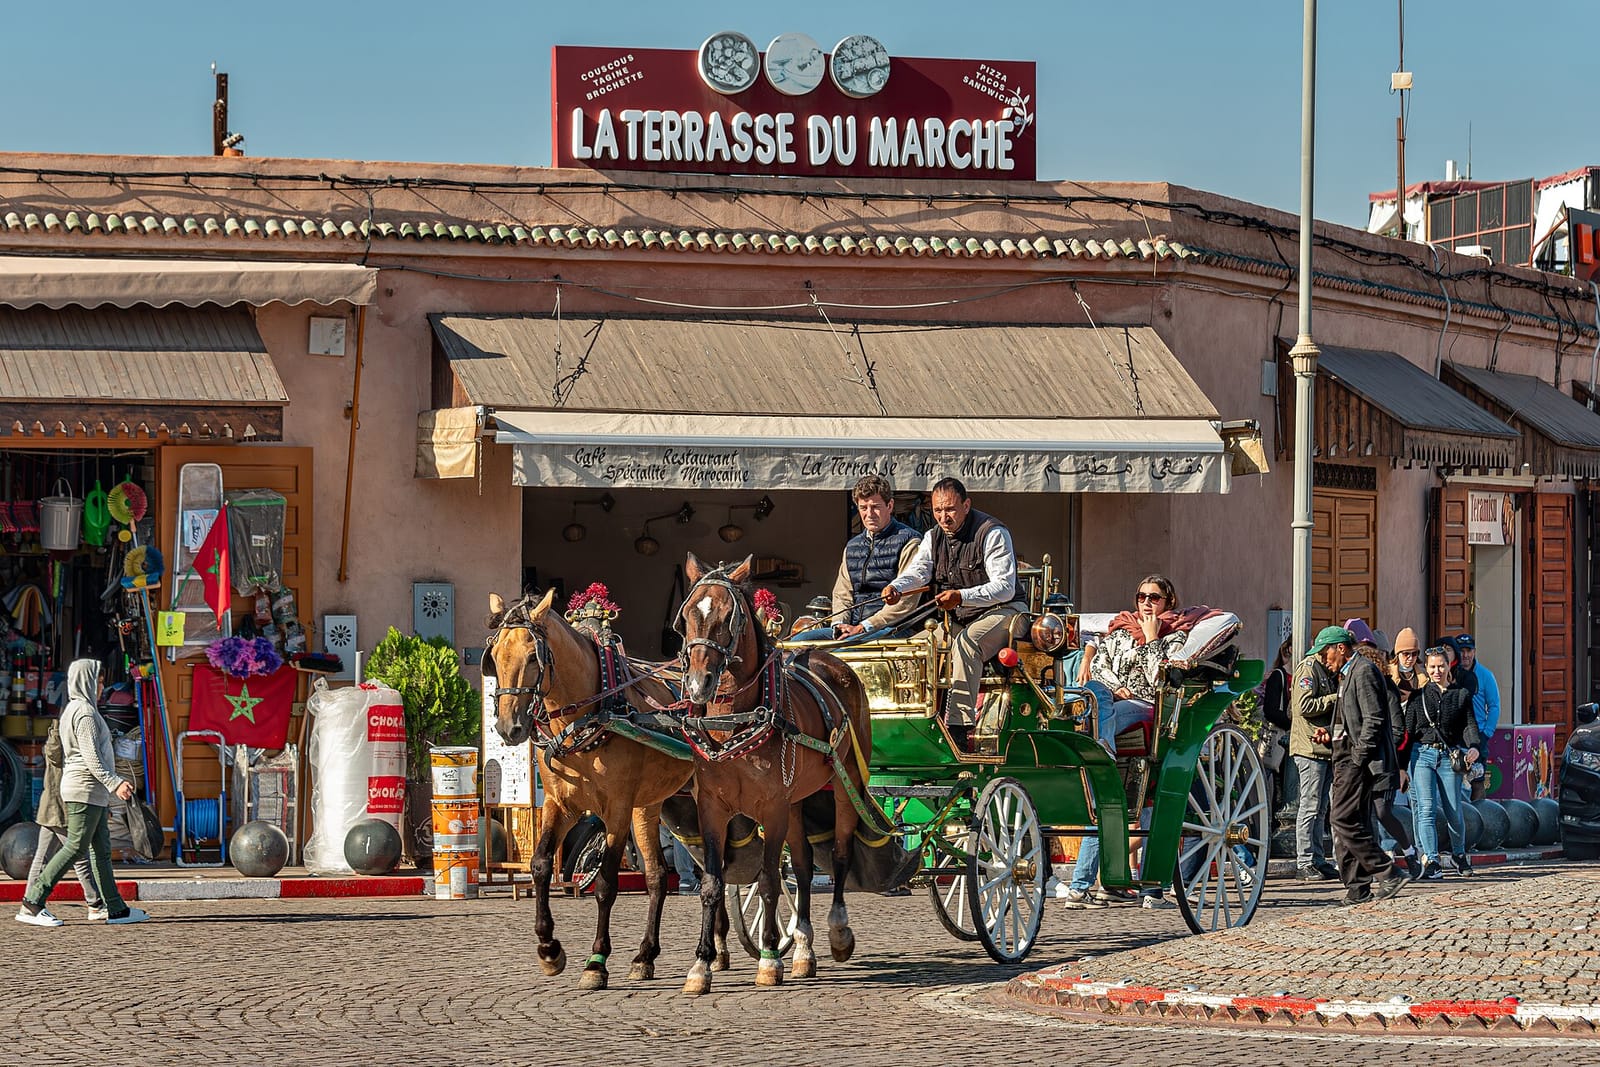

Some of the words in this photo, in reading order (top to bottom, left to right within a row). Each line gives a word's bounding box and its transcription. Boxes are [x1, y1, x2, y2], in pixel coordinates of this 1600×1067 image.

[581, 54, 634, 81] COUSCOUS
[593, 67, 629, 86] TAGINE
[980, 63, 1007, 82] PIZZA
[586, 71, 644, 100] BROCHETTE
[976, 71, 1005, 91] TACOS
[572, 107, 619, 160] LA
[620, 109, 797, 165] TERRASSE
[807, 114, 857, 166] DU
[869, 107, 1015, 170] MARCHÉ
[575, 446, 607, 468] Café
[663, 448, 739, 466] Restaurant
[801, 455, 822, 476] La
[831, 456, 898, 477] Terrasse
[915, 456, 934, 477] du
[961, 455, 1020, 478] Marché
[601, 463, 667, 484] Spécialité
[680, 466, 749, 485] Marocaine
